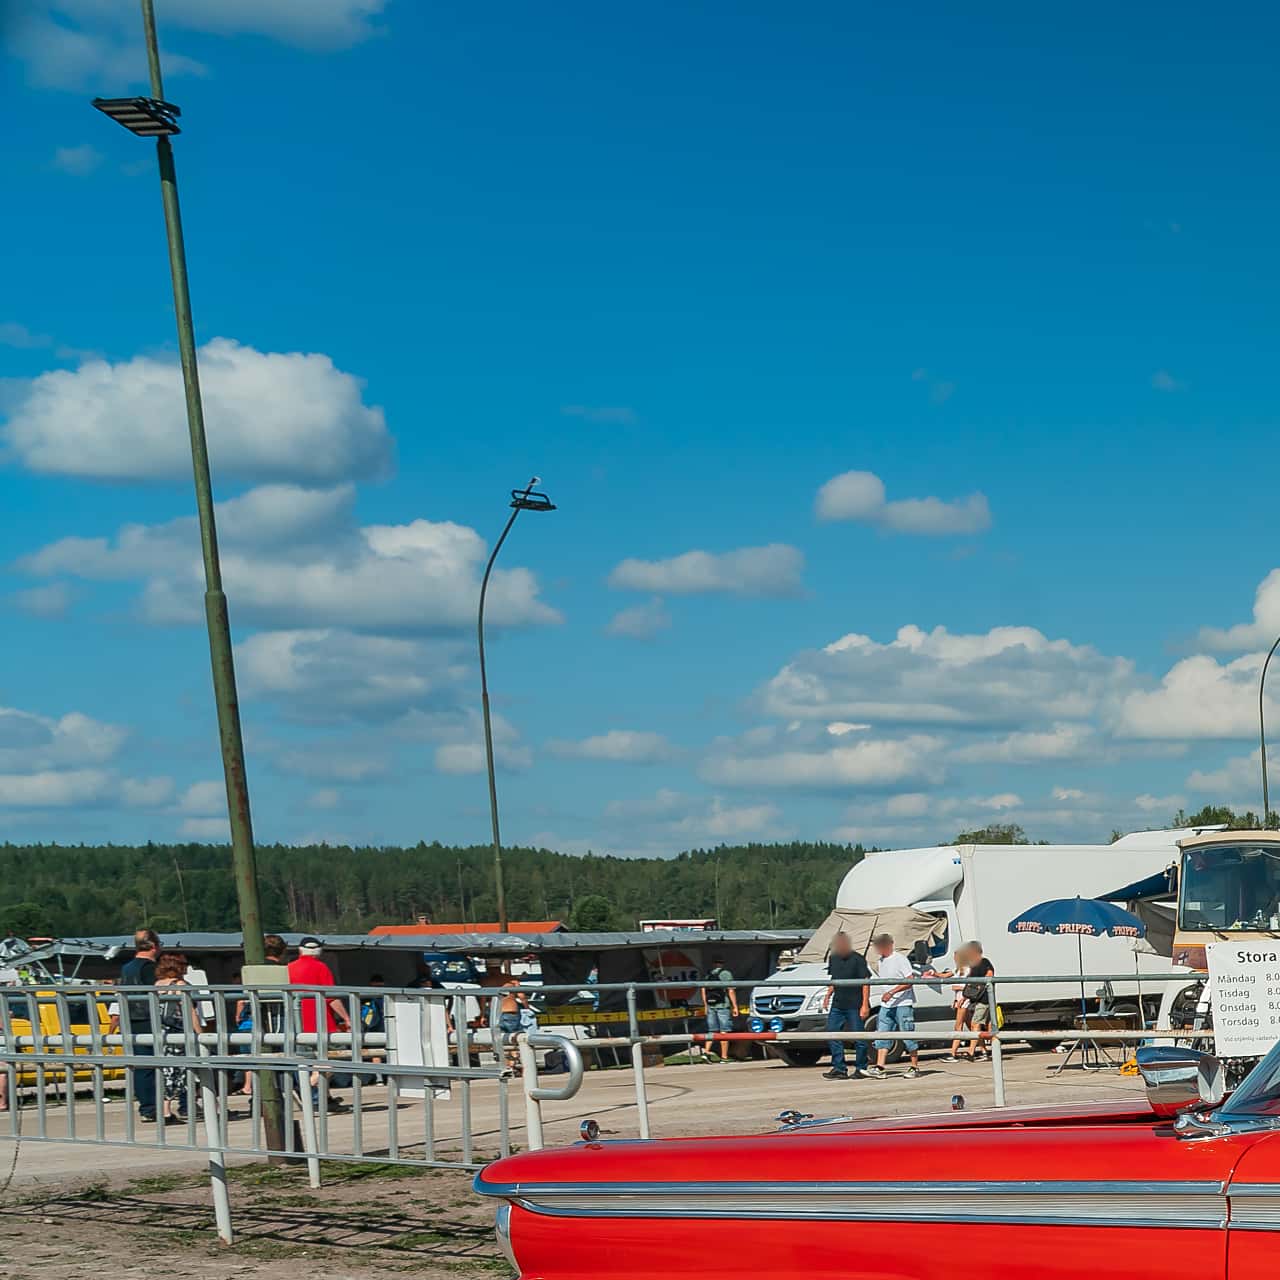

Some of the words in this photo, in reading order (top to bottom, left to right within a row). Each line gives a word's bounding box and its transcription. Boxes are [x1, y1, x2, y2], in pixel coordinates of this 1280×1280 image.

[1018, 921, 1041, 932] PRIPPS
[1059, 923, 1093, 934] PRIPPS
[1113, 926, 1138, 937] PRIPPS
[1237, 950, 1277, 964] Stora
[1217, 974, 1256, 985] Måndag
[1219, 989, 1250, 999] Tisdag
[1219, 1003, 1257, 1013] Onsdag
[1221, 1017, 1260, 1027] Torsdag
